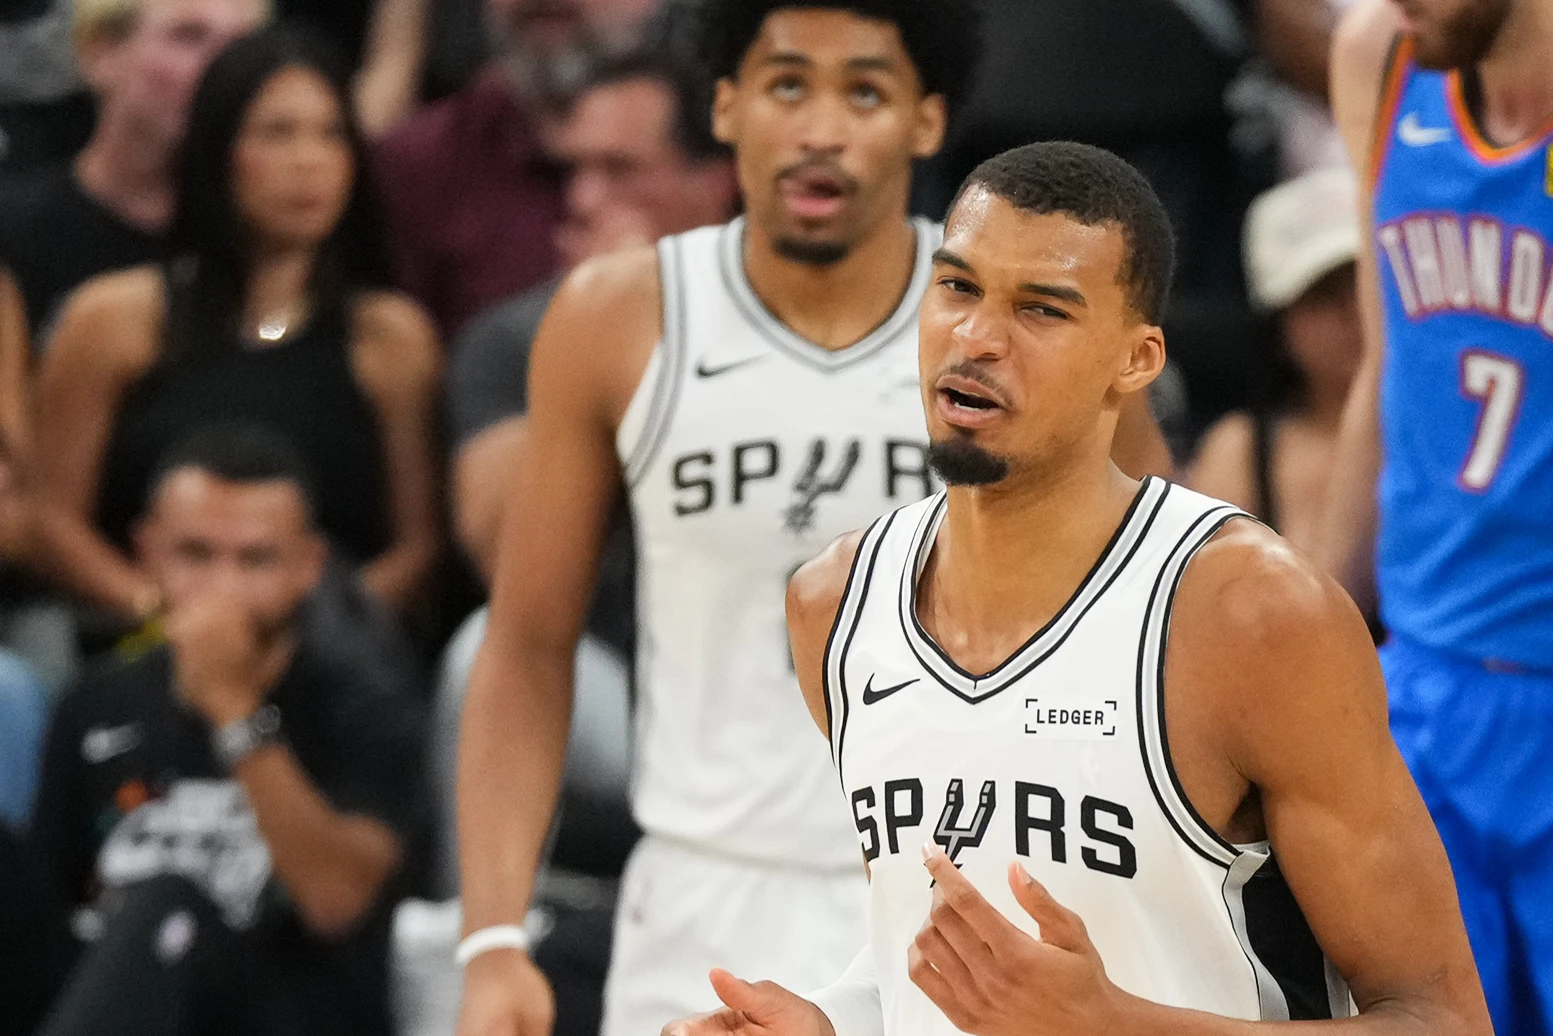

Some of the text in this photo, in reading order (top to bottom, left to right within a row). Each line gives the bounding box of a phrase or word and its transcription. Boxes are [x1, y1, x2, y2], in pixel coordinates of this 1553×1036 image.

[1459, 348, 1524, 493] 7
[672, 436, 932, 534] SPUR
[1037, 709, 1104, 726] LEDGER
[852, 777, 1137, 888] SPURS
